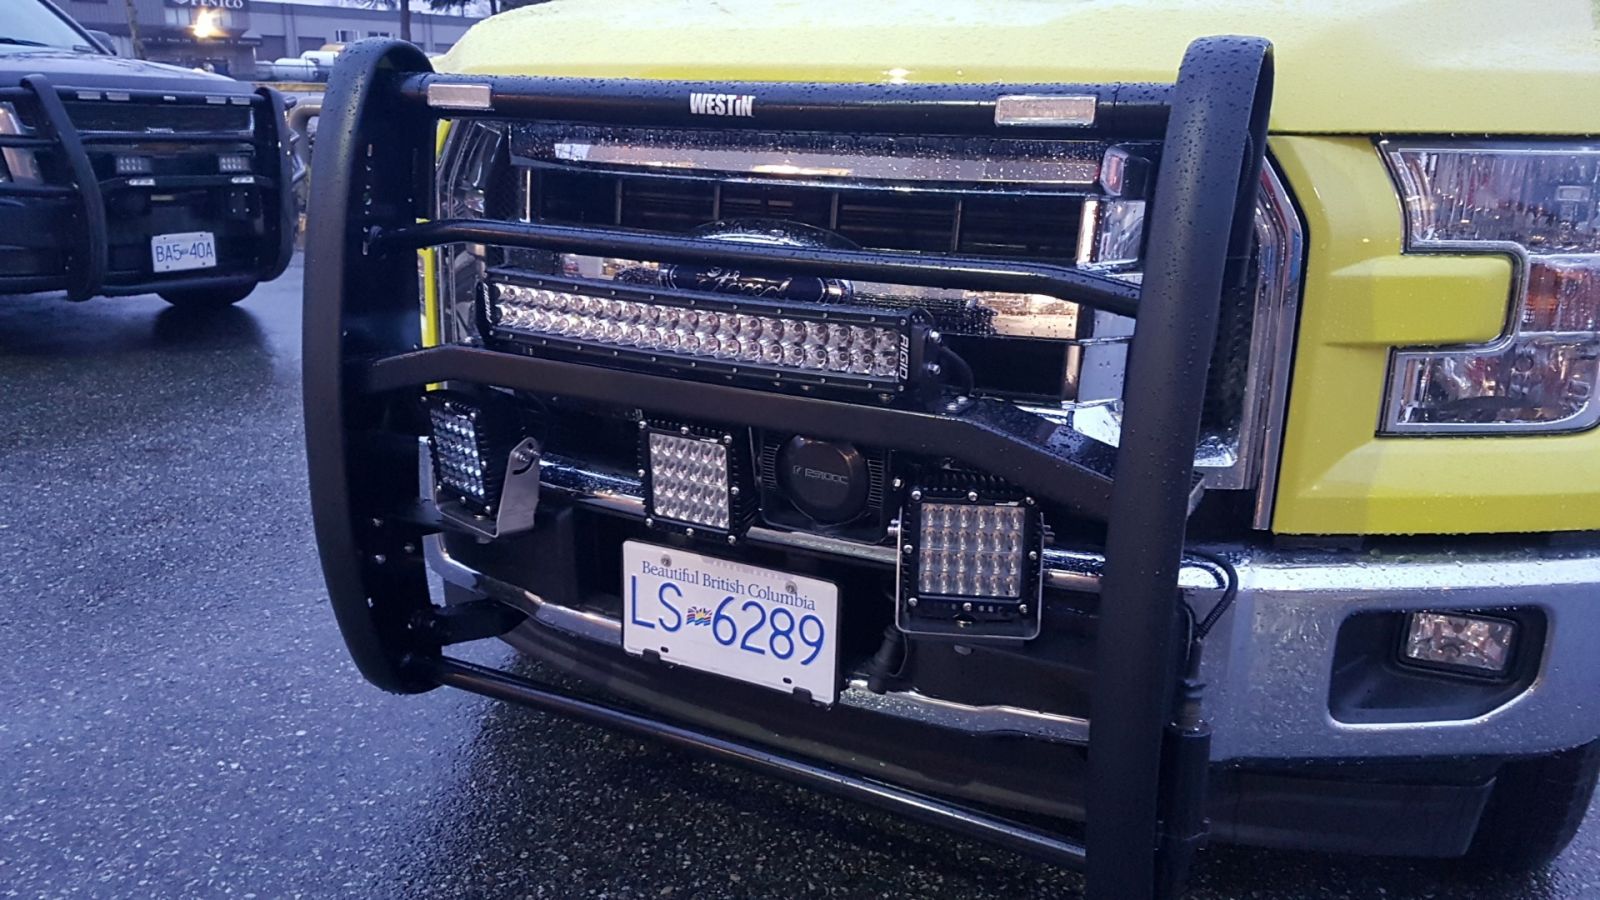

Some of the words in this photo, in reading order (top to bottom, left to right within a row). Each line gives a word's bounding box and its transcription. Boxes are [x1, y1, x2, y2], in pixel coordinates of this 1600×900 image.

[190, 242, 214, 258] 40A
[900, 334, 909, 380] RIGID
[642, 561, 699, 585] Beautiful
[702, 573, 745, 595] British
[748, 583, 816, 611] Columbia
[631, 575, 683, 633] LS
[712, 596, 825, 666] 6289
